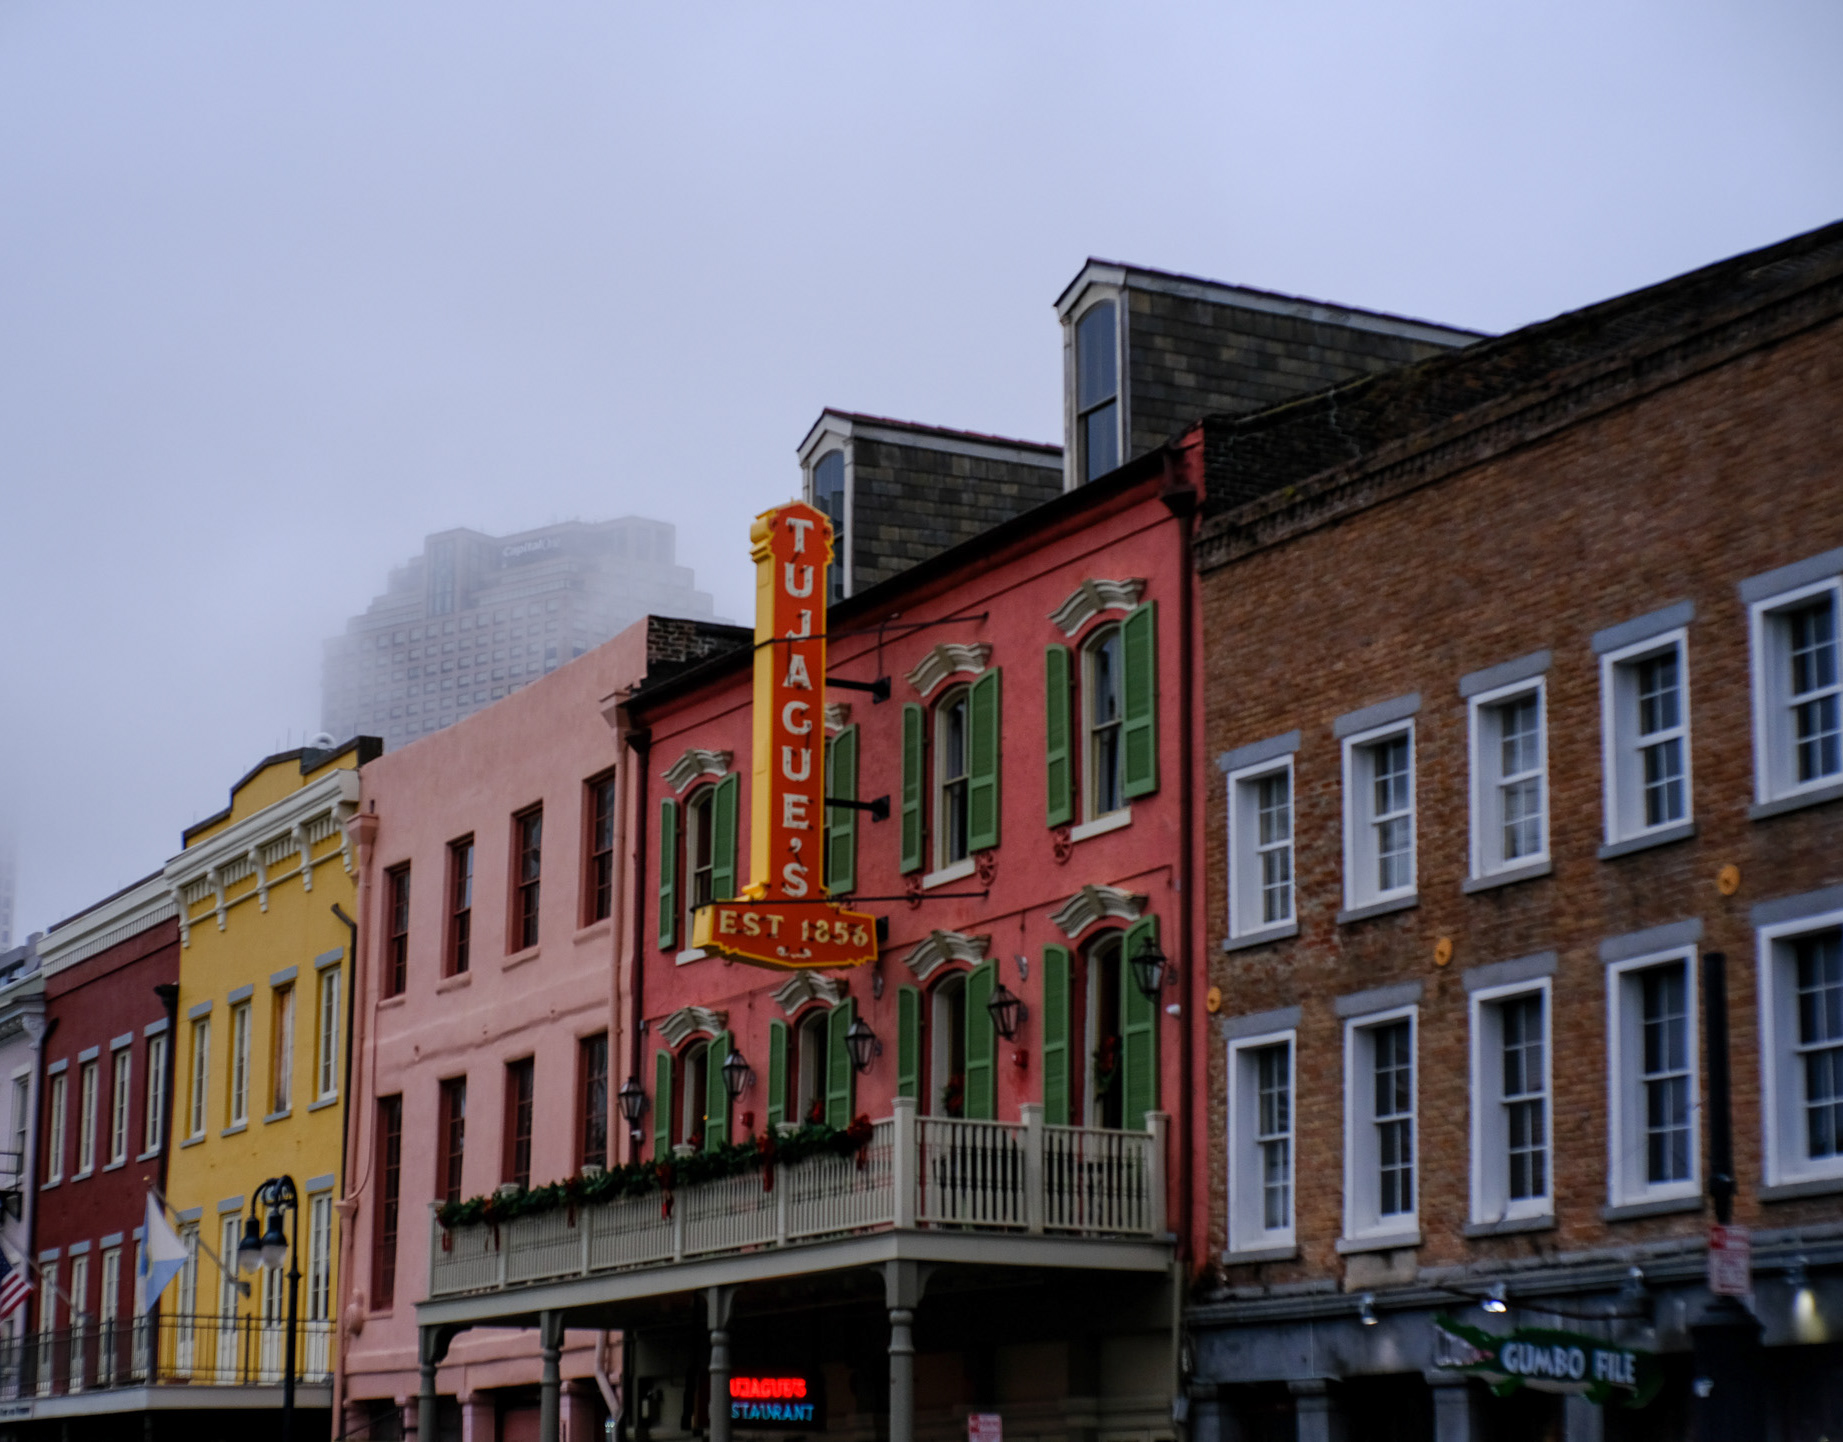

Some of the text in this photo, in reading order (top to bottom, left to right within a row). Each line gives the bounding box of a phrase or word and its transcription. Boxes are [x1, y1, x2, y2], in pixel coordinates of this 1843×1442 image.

[781, 517, 814, 898] TUJAGUE'S
[718, 909, 868, 947] EST 1856
[1500, 1342, 1637, 1385] GUMBO FILE
[730, 1401, 815, 1421] STAURANT
